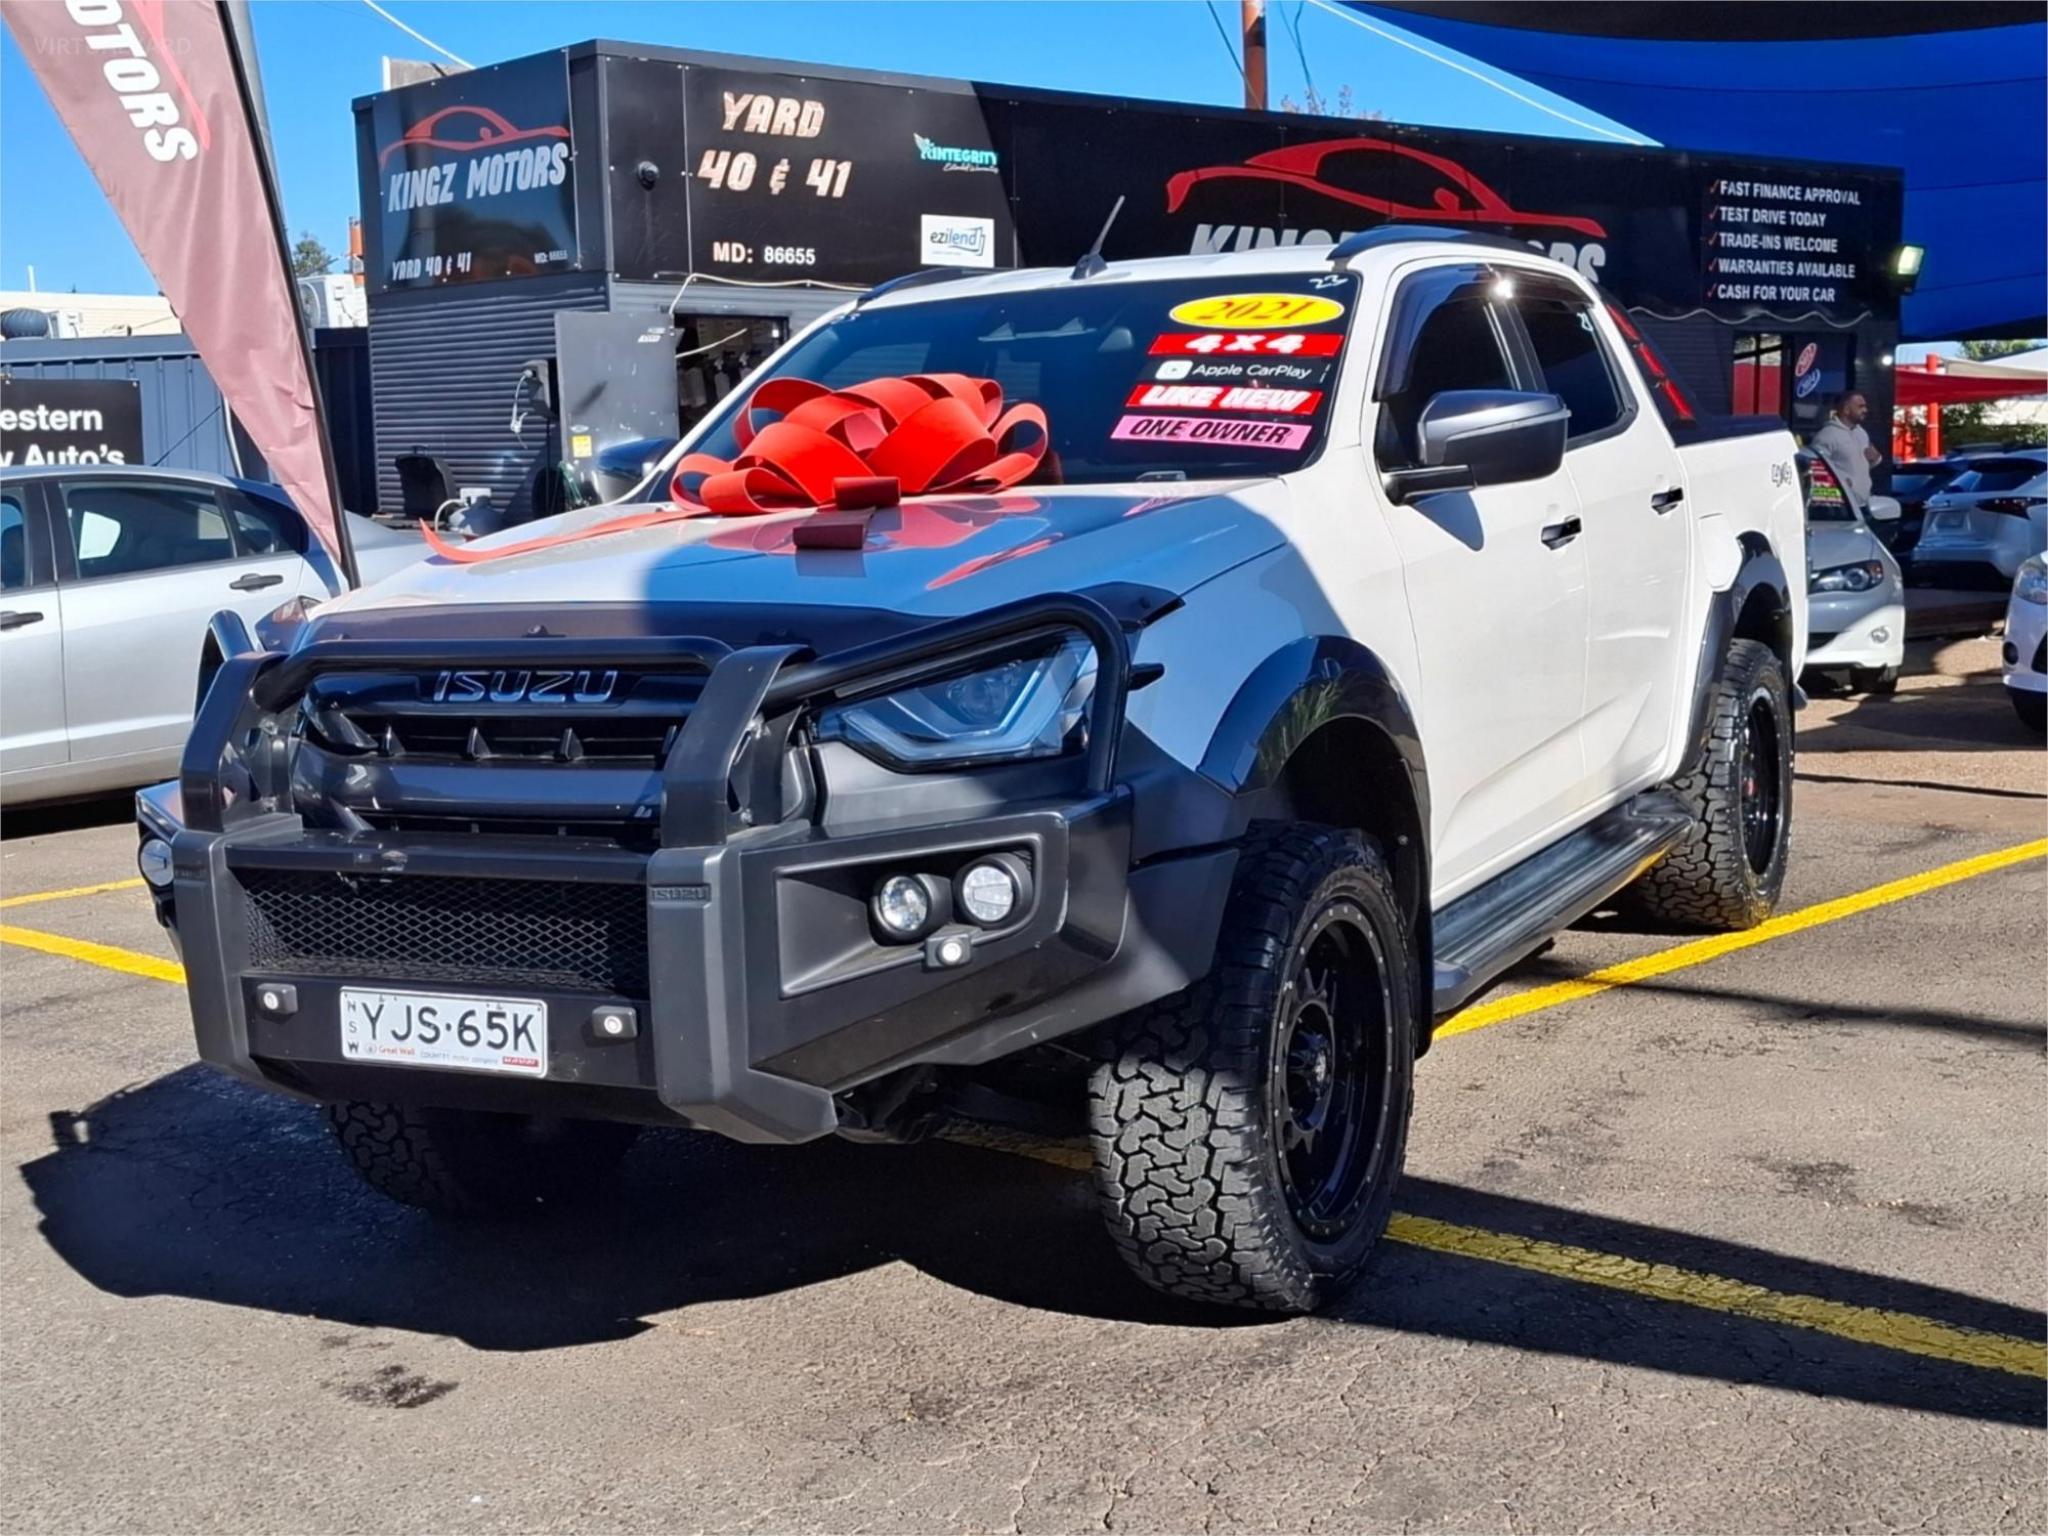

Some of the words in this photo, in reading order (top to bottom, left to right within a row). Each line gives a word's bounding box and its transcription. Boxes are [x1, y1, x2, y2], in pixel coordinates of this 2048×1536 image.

[722, 91, 825, 138] YARD
[388, 162, 457, 212] KINGZ
[466, 142, 568, 199] MOTORS
[697, 149, 757, 191] 40
[806, 158, 852, 198] 41
[1719, 180, 1750, 196] FAST
[1753, 182, 1802, 201] FINANCE
[1804, 187, 1861, 206] APPROVAL
[1719, 206, 1750, 222] TEST
[1752, 208, 1786, 225] DRIVE
[1789, 210, 1827, 228] TODAY
[930, 228, 977, 246] ezilend
[1719, 232, 1781, 250] TRADE-INS
[1784, 235, 1838, 253] WELCOME
[713, 241, 754, 264] MD:
[763, 245, 816, 265] 86655
[392, 257, 422, 281] YARD
[425, 255, 442, 277] 40
[457, 252, 472, 273] 41
[1718, 258, 1794, 276] WARRANTIES
[1796, 261, 1856, 278] AVAILABLE
[1309, 274, 1349, 290] 23
[1717, 284, 1750, 300] CASH
[1753, 285, 1777, 300] FOR
[1779, 286, 1810, 301] YOUR
[1812, 287, 1836, 302] CAR
[1195, 300, 1315, 321] 2021
[1192, 363, 1243, 378] Apple
[1246, 363, 1312, 380] CarPlay
[1140, 385, 1224, 408] LIKE
[1218, 388, 1311, 412] NEW
[1129, 418, 1189, 438] ONE
[1189, 420, 1292, 444] OWNER
[434, 670, 618, 703] ISUZU
